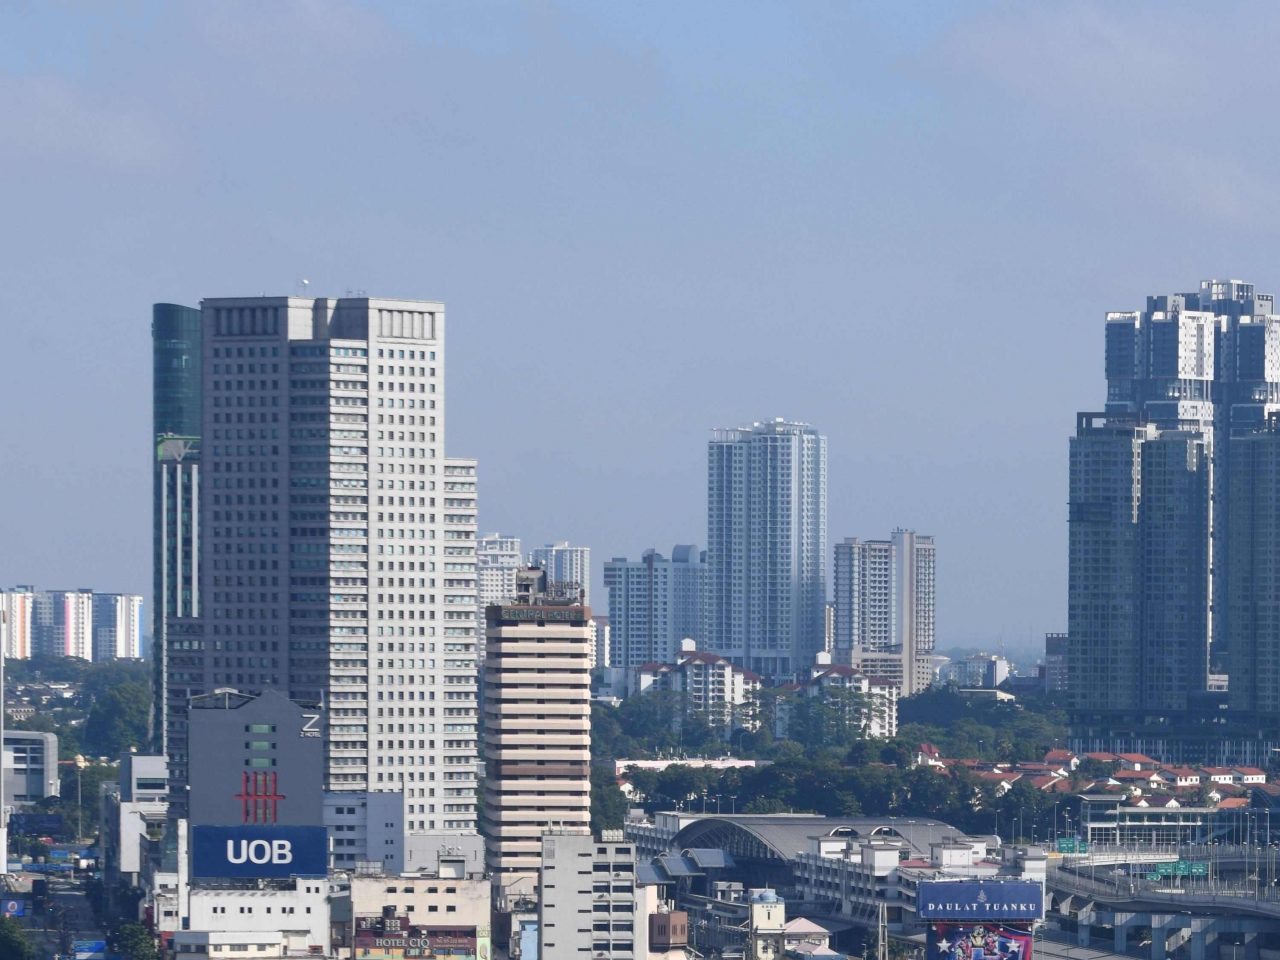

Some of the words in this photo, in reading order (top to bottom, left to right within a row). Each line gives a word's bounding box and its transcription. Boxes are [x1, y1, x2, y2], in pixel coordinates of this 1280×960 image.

[502, 609, 545, 619] CENTRAL
[547, 610, 575, 619] HOTEL
[302, 714, 320, 731] Z
[227, 840, 292, 864] UOB
[410, 938, 430, 948] CIQ
